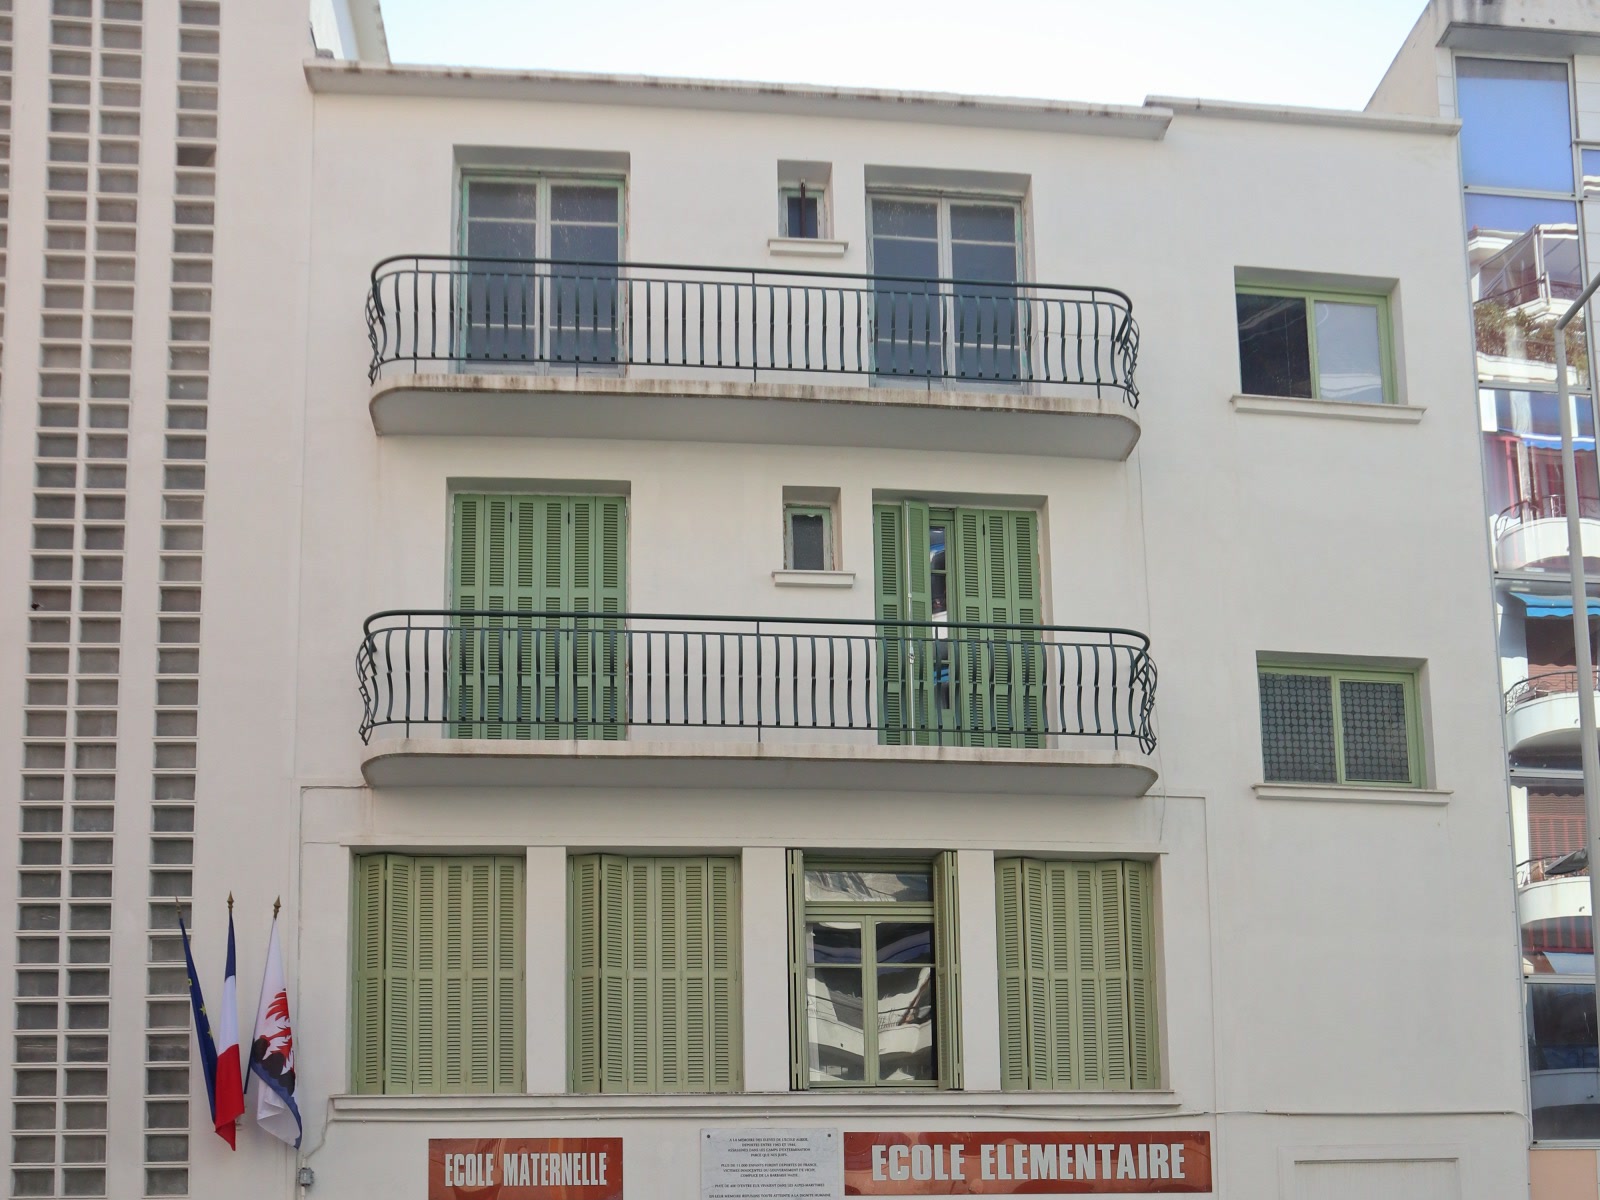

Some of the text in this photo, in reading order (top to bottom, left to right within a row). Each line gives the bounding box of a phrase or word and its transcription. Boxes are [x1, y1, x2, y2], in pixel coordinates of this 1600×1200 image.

[445, 1152, 608, 1187] ECOLE MATERNELLE
[871, 1143, 1186, 1181] ECOLE ELEMENTAIRE
